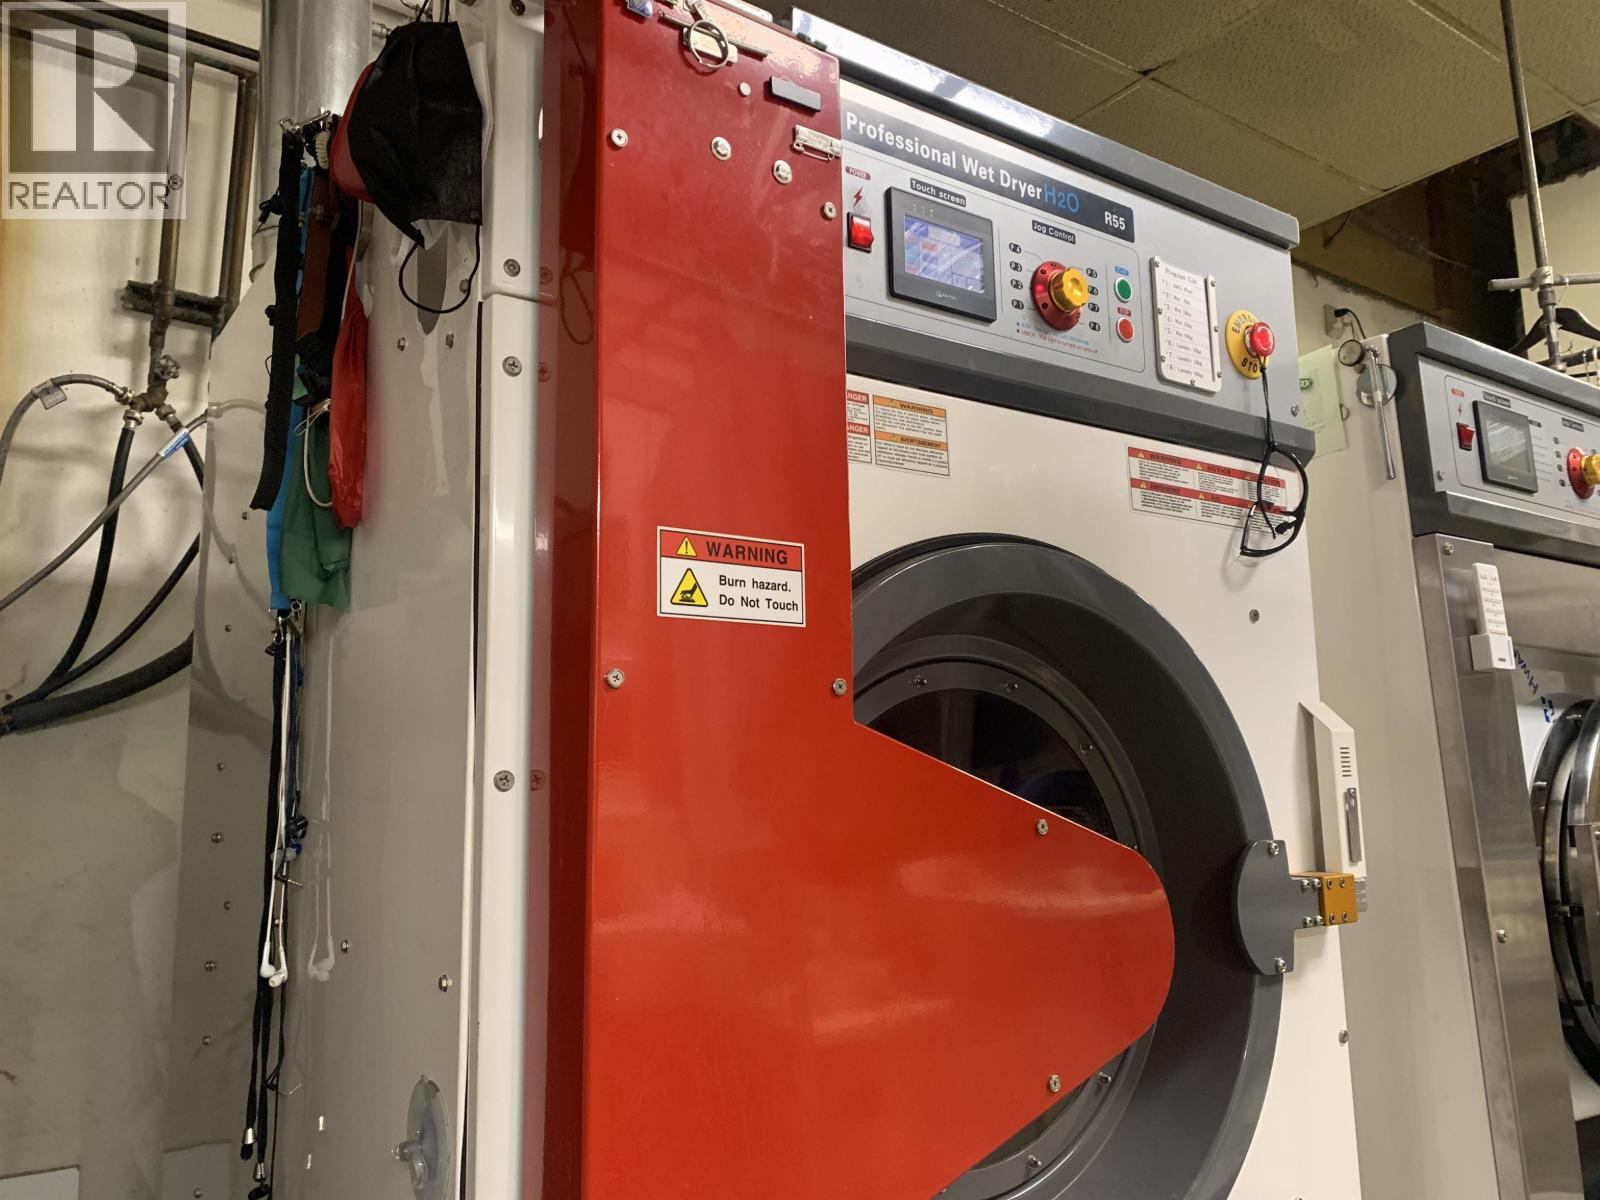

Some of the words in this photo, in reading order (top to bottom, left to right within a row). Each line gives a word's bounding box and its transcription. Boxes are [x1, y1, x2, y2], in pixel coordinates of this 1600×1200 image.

[846, 112, 957, 169] Professional
[961, 154, 995, 184] Wet
[999, 169, 1043, 200] Dryer
[1043, 183, 1080, 214] H2O
[1104, 211, 1126, 231] R55
[911, 180, 936, 196] Touch
[938, 190, 966, 206] screen
[1033, 222, 1047, 234] Jog
[1048, 228, 1075, 242] Control
[1241, 357, 1258, 373] STO
[847, 393, 867, 402] NGER
[899, 402, 934, 414] WARNING
[847, 425, 869, 434] NGER
[705, 541, 788, 565] WARNING
[718, 574, 746, 588] Burn
[752, 577, 791, 592] hazard.
[719, 594, 735, 606] Do
[740, 595, 760, 608] Not
[765, 597, 799, 611] Touch
